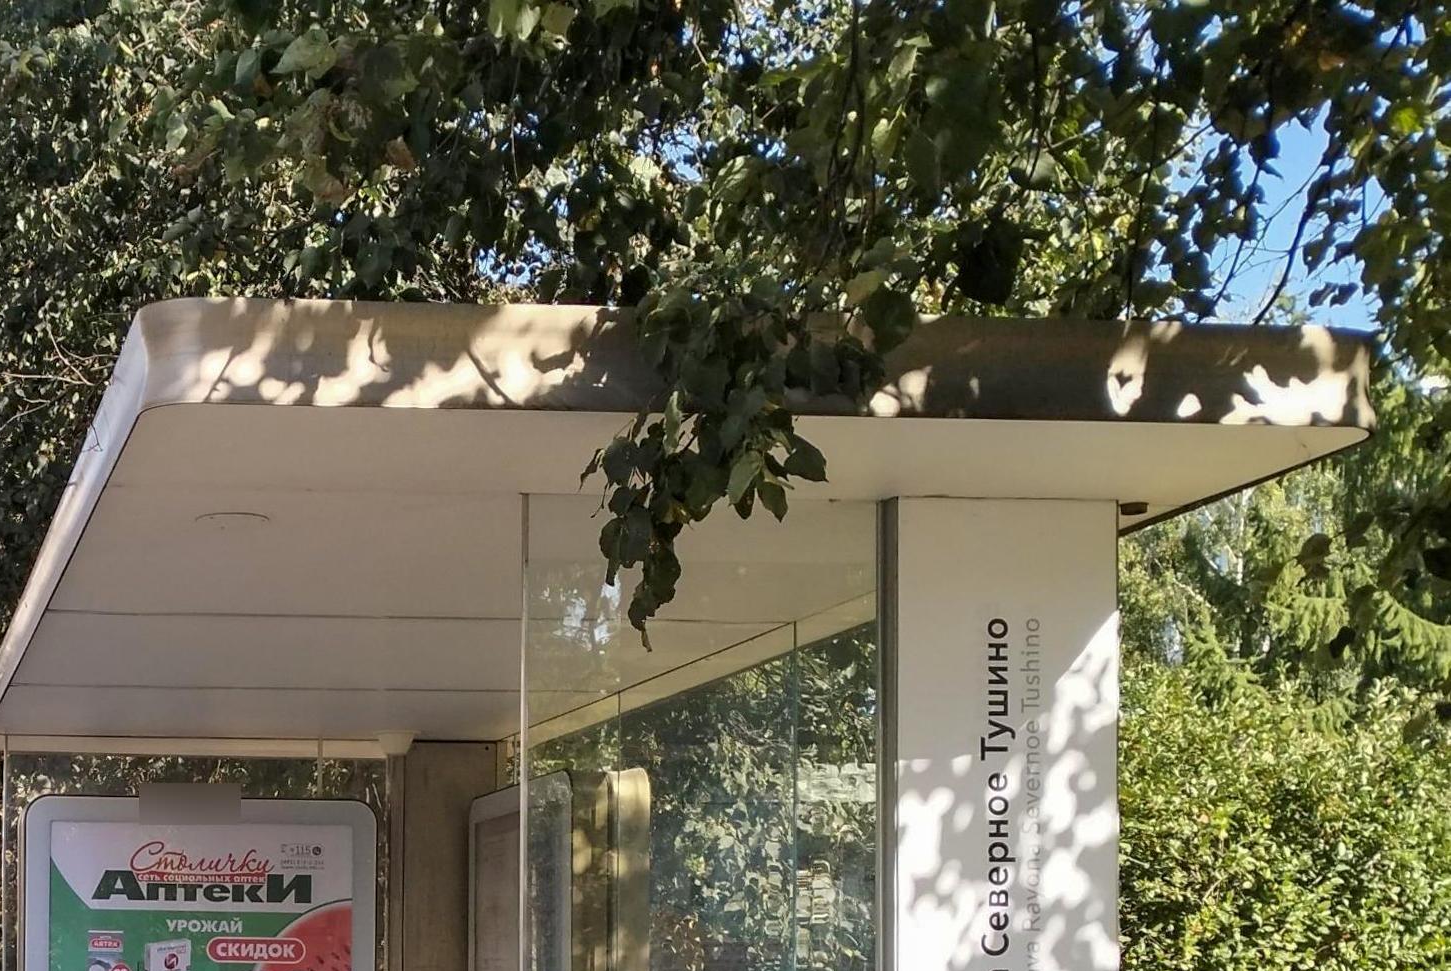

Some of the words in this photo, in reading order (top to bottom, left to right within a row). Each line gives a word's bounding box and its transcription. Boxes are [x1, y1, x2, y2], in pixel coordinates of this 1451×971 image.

[980, 618, 1016, 761] Тушино
[1020, 618, 1041, 713] Tushino
[1021, 720, 1041, 836] Severnoe
[130, 841, 275, 875] Столички
[233, 875, 265, 884] аптек
[981, 772, 1016, 956] Северное
[166, 917, 243, 933] УРОЖАЙ
[216, 942, 295, 959] СКИДОК
